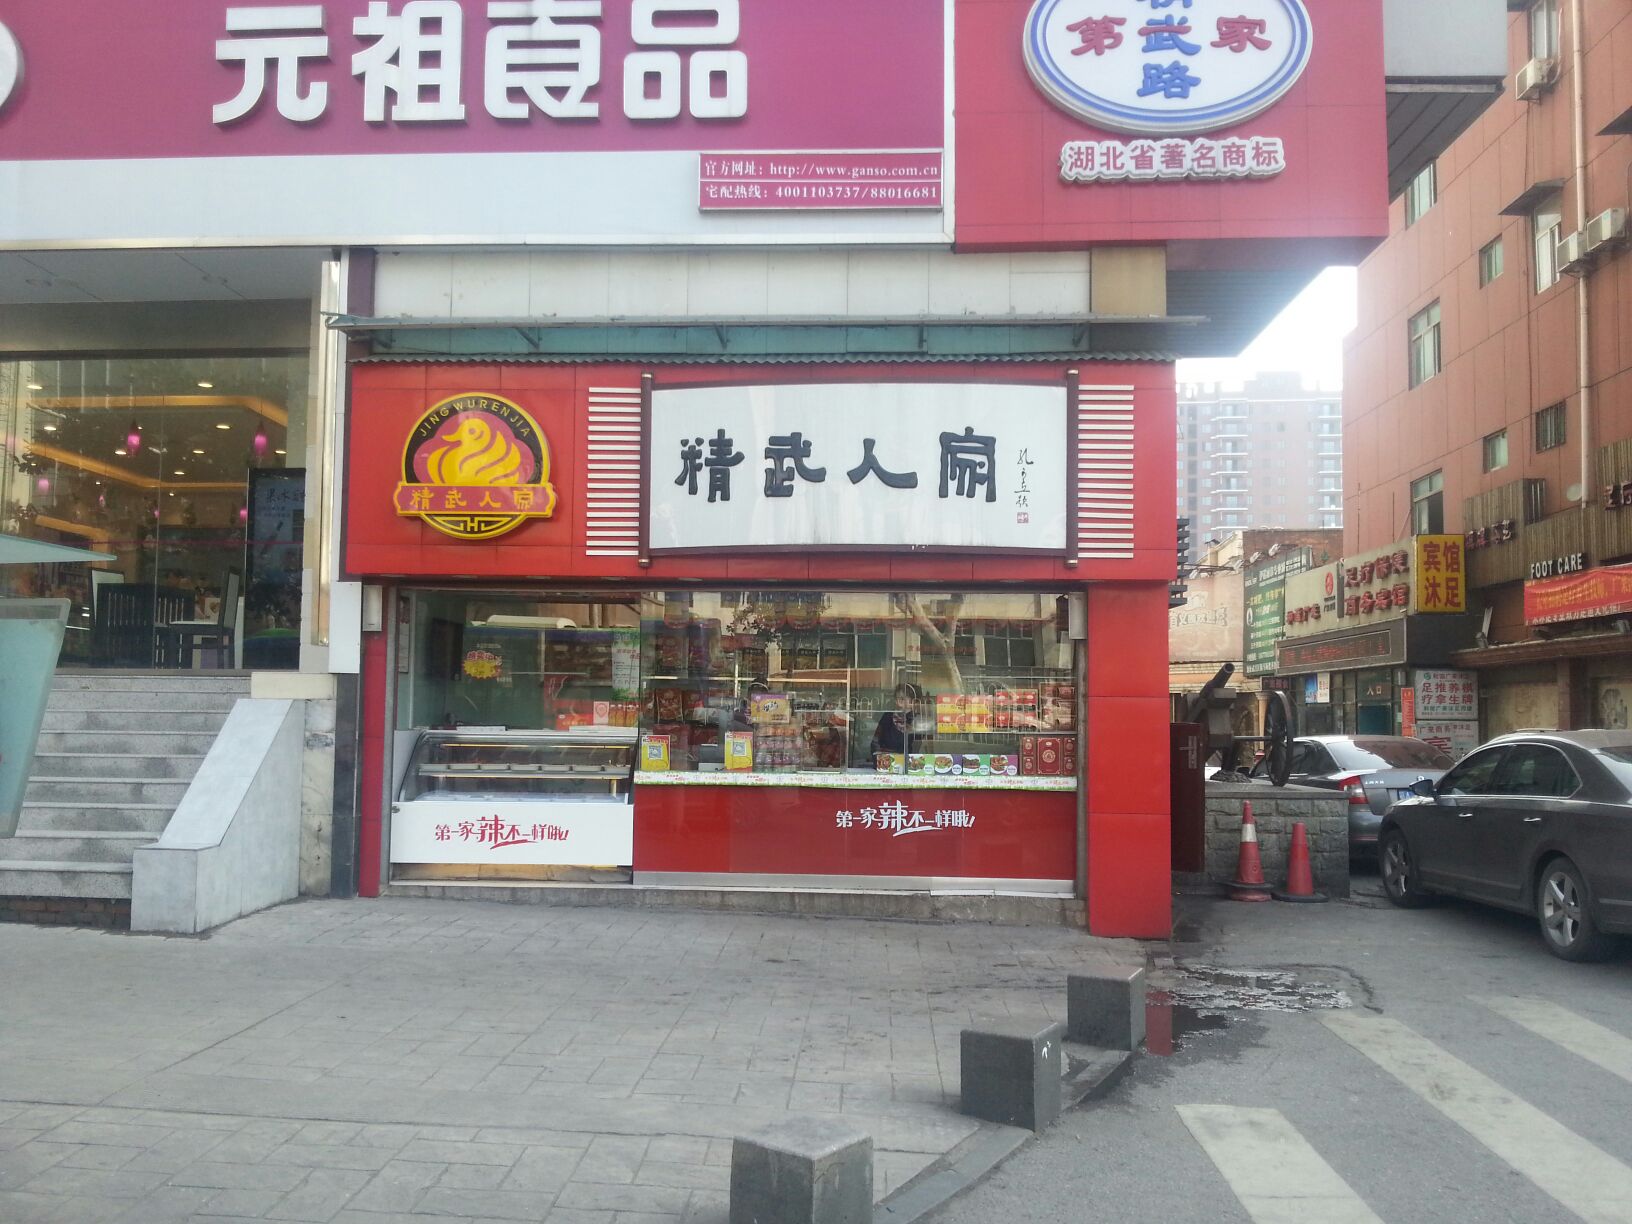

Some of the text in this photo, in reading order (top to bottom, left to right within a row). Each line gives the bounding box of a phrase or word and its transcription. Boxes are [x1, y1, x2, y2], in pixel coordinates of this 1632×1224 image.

[213, 0, 748, 123] 元祖食品
[1137, 0, 1202, 99] 武路
[1067, 141, 1280, 172] 湖北省著名商标
[1423, 541, 1460, 572] 宾馆
[1530, 553, 1583, 579] FOOT CARE
[1424, 576, 1461, 608] 沐足
